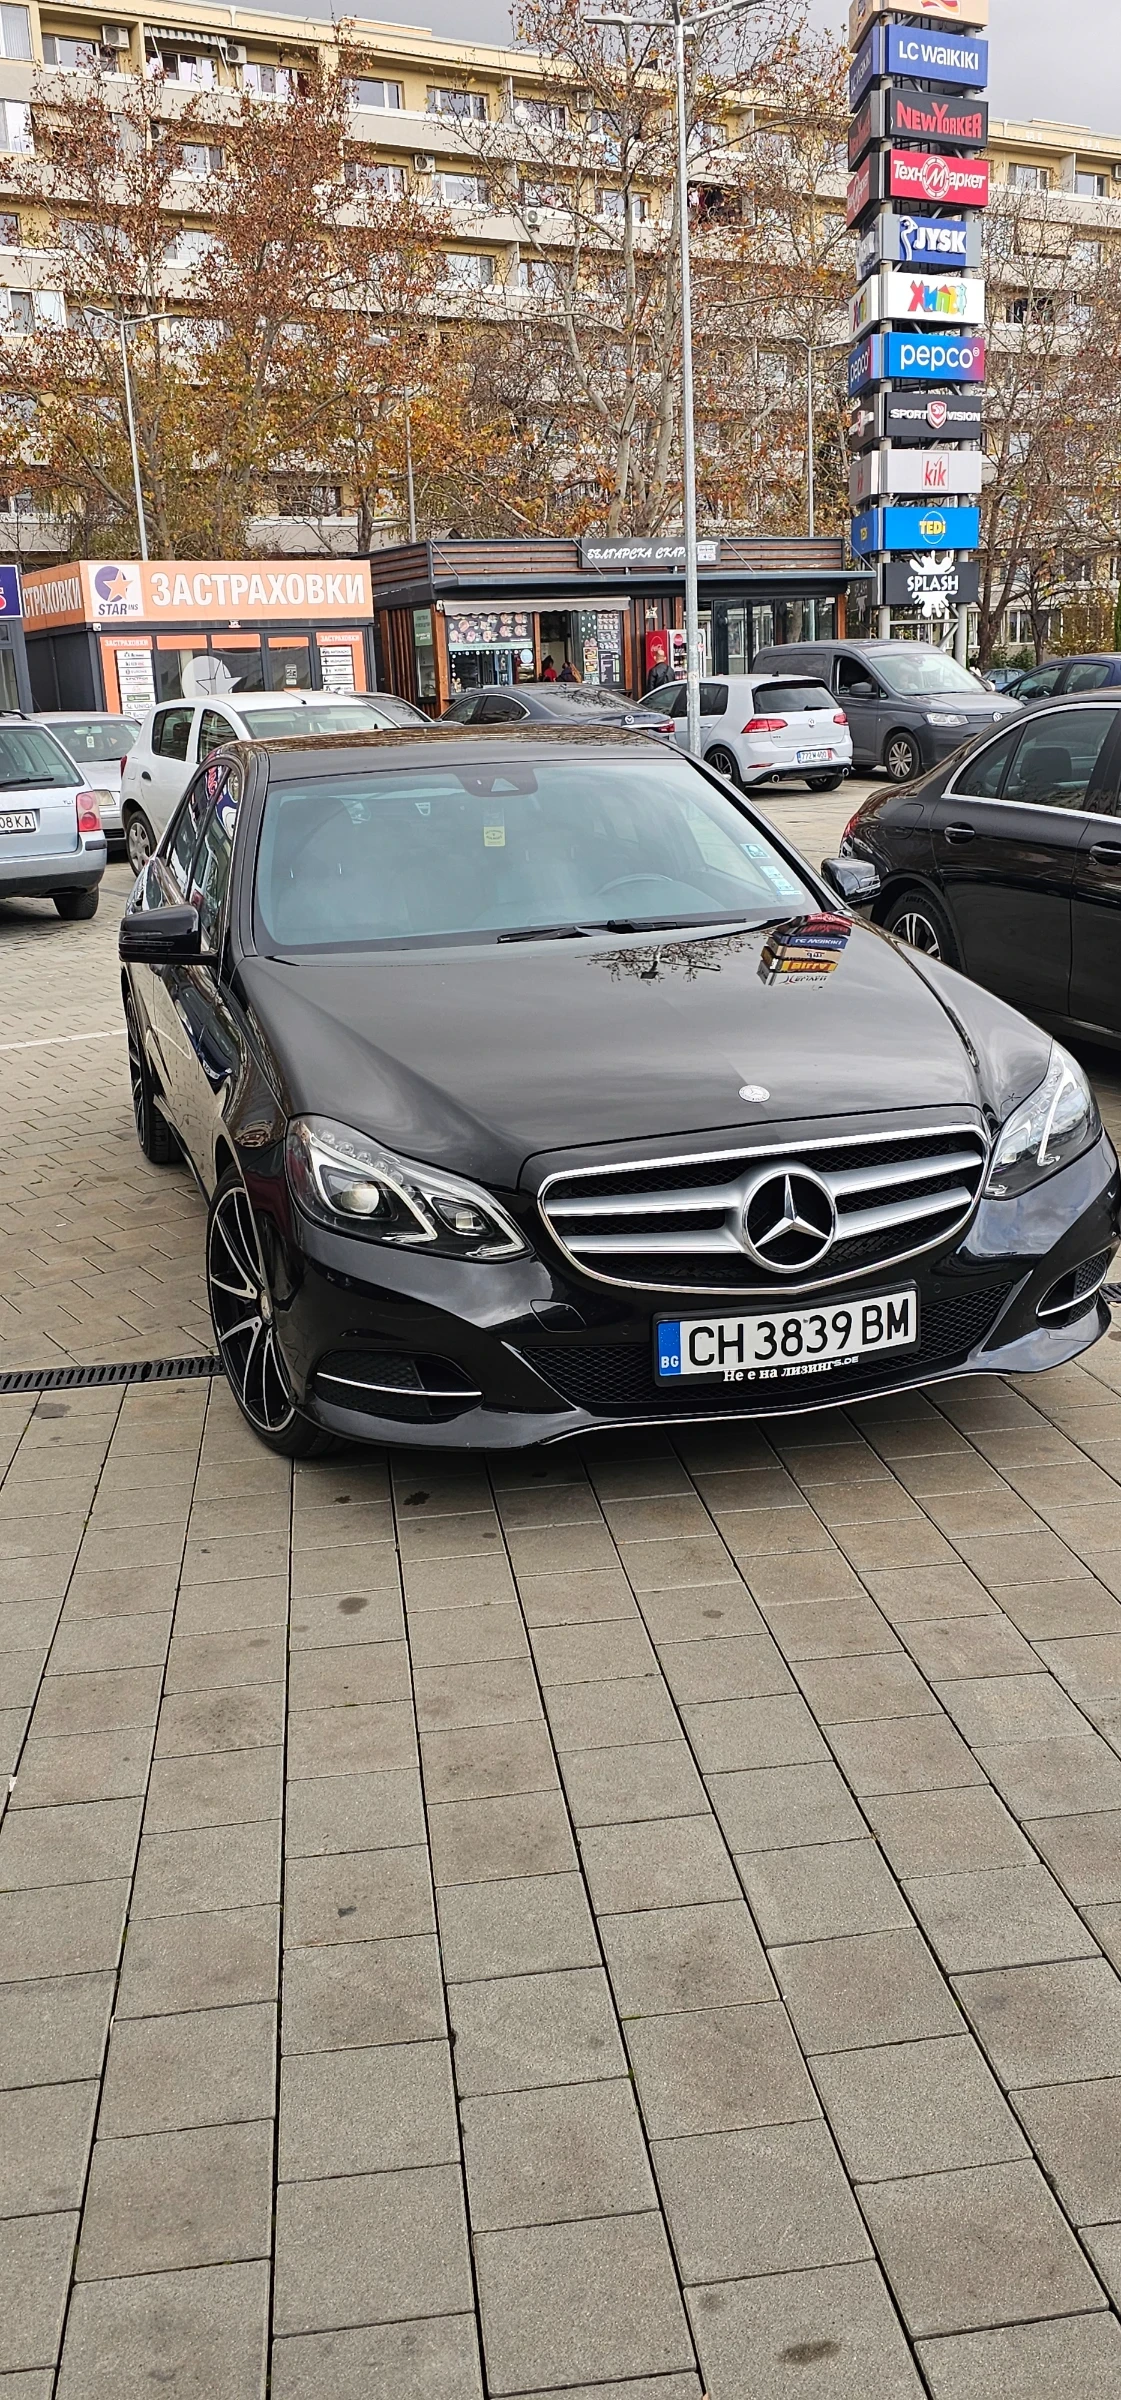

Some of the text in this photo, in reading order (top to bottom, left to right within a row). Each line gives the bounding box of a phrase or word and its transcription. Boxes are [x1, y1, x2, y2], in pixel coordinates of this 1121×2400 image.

[899, 41, 919, 60] LC
[914, 228, 967, 253] JYSK
[900, 343, 973, 371] pepco
[890, 408, 981, 423] SPORT VISION
[924, 457, 947, 487] kik
[919, 520, 946, 535] TEDi
[655, 546, 686, 559] СКАР
[150, 572, 366, 607] ЗАСТРАХОВКИ
[907, 575, 959, 592] SPLASH
[22, 577, 82, 618] СТРАХОВКИ
[98, 603, 139, 616] STAR INS
[688, 1298, 910, 1367] CH 3839 BM
[661, 1355, 679, 1369] BG
[723, 1370, 744, 1382] Не
[747, 1371, 756, 1380] е
[759, 1369, 778, 1379] на
